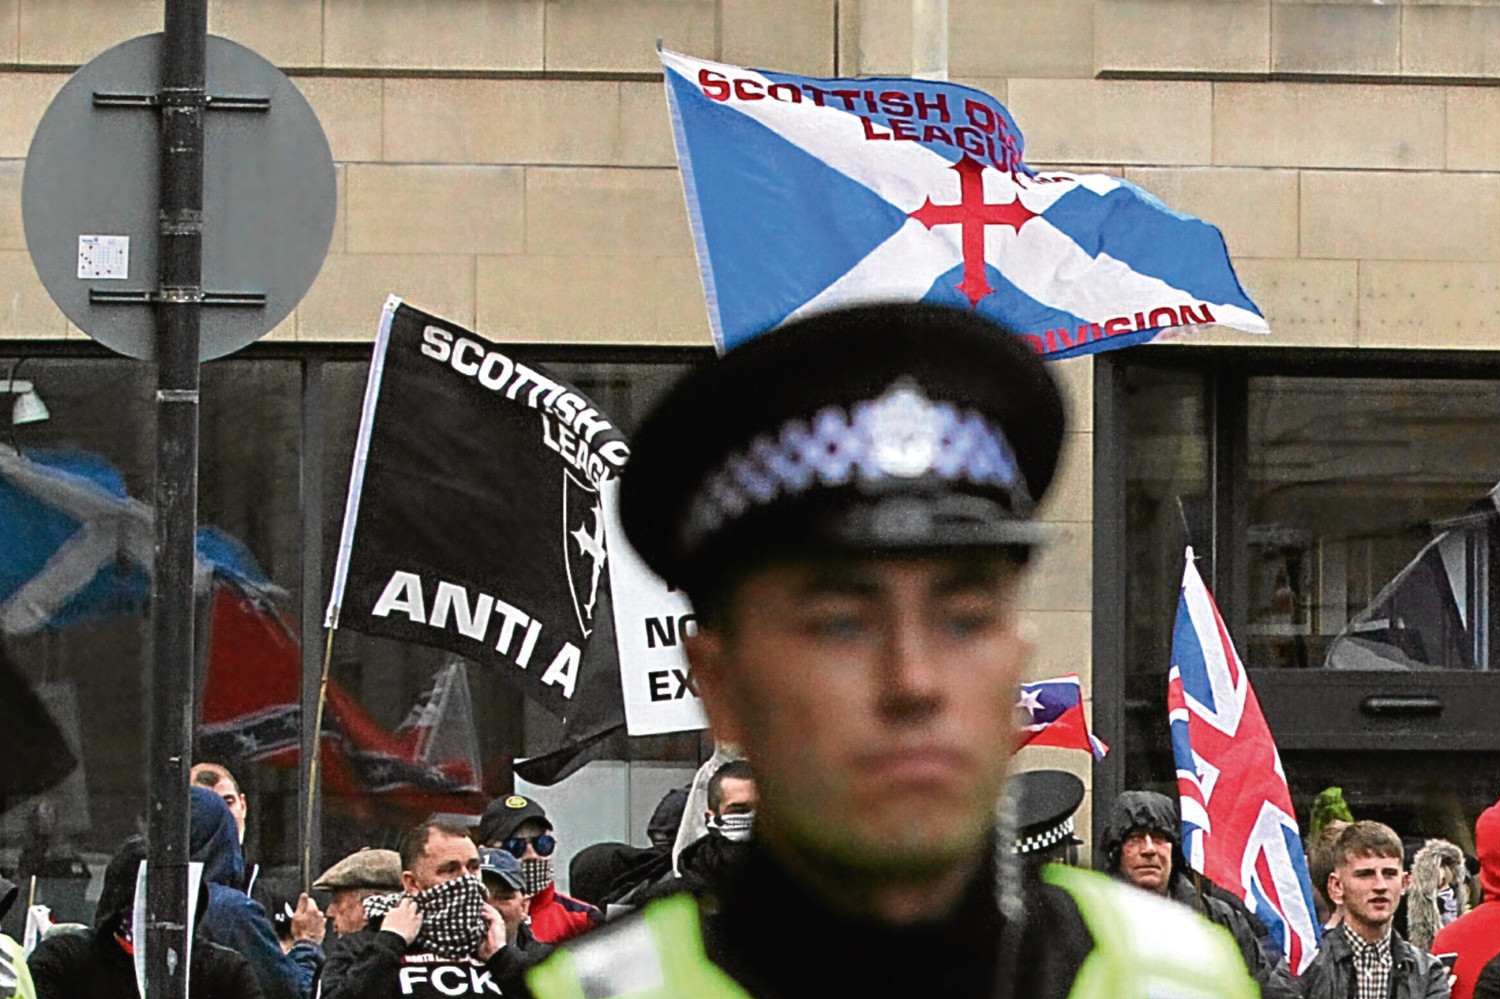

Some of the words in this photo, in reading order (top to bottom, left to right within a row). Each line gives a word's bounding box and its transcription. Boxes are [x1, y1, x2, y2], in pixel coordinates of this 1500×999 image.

[698, 68, 950, 123] SCOTTISH
[420, 324, 613, 444] SCOTTISH
[371, 570, 543, 669] ANTI
[540, 641, 582, 700] A
[399, 965, 504, 996] FCK
